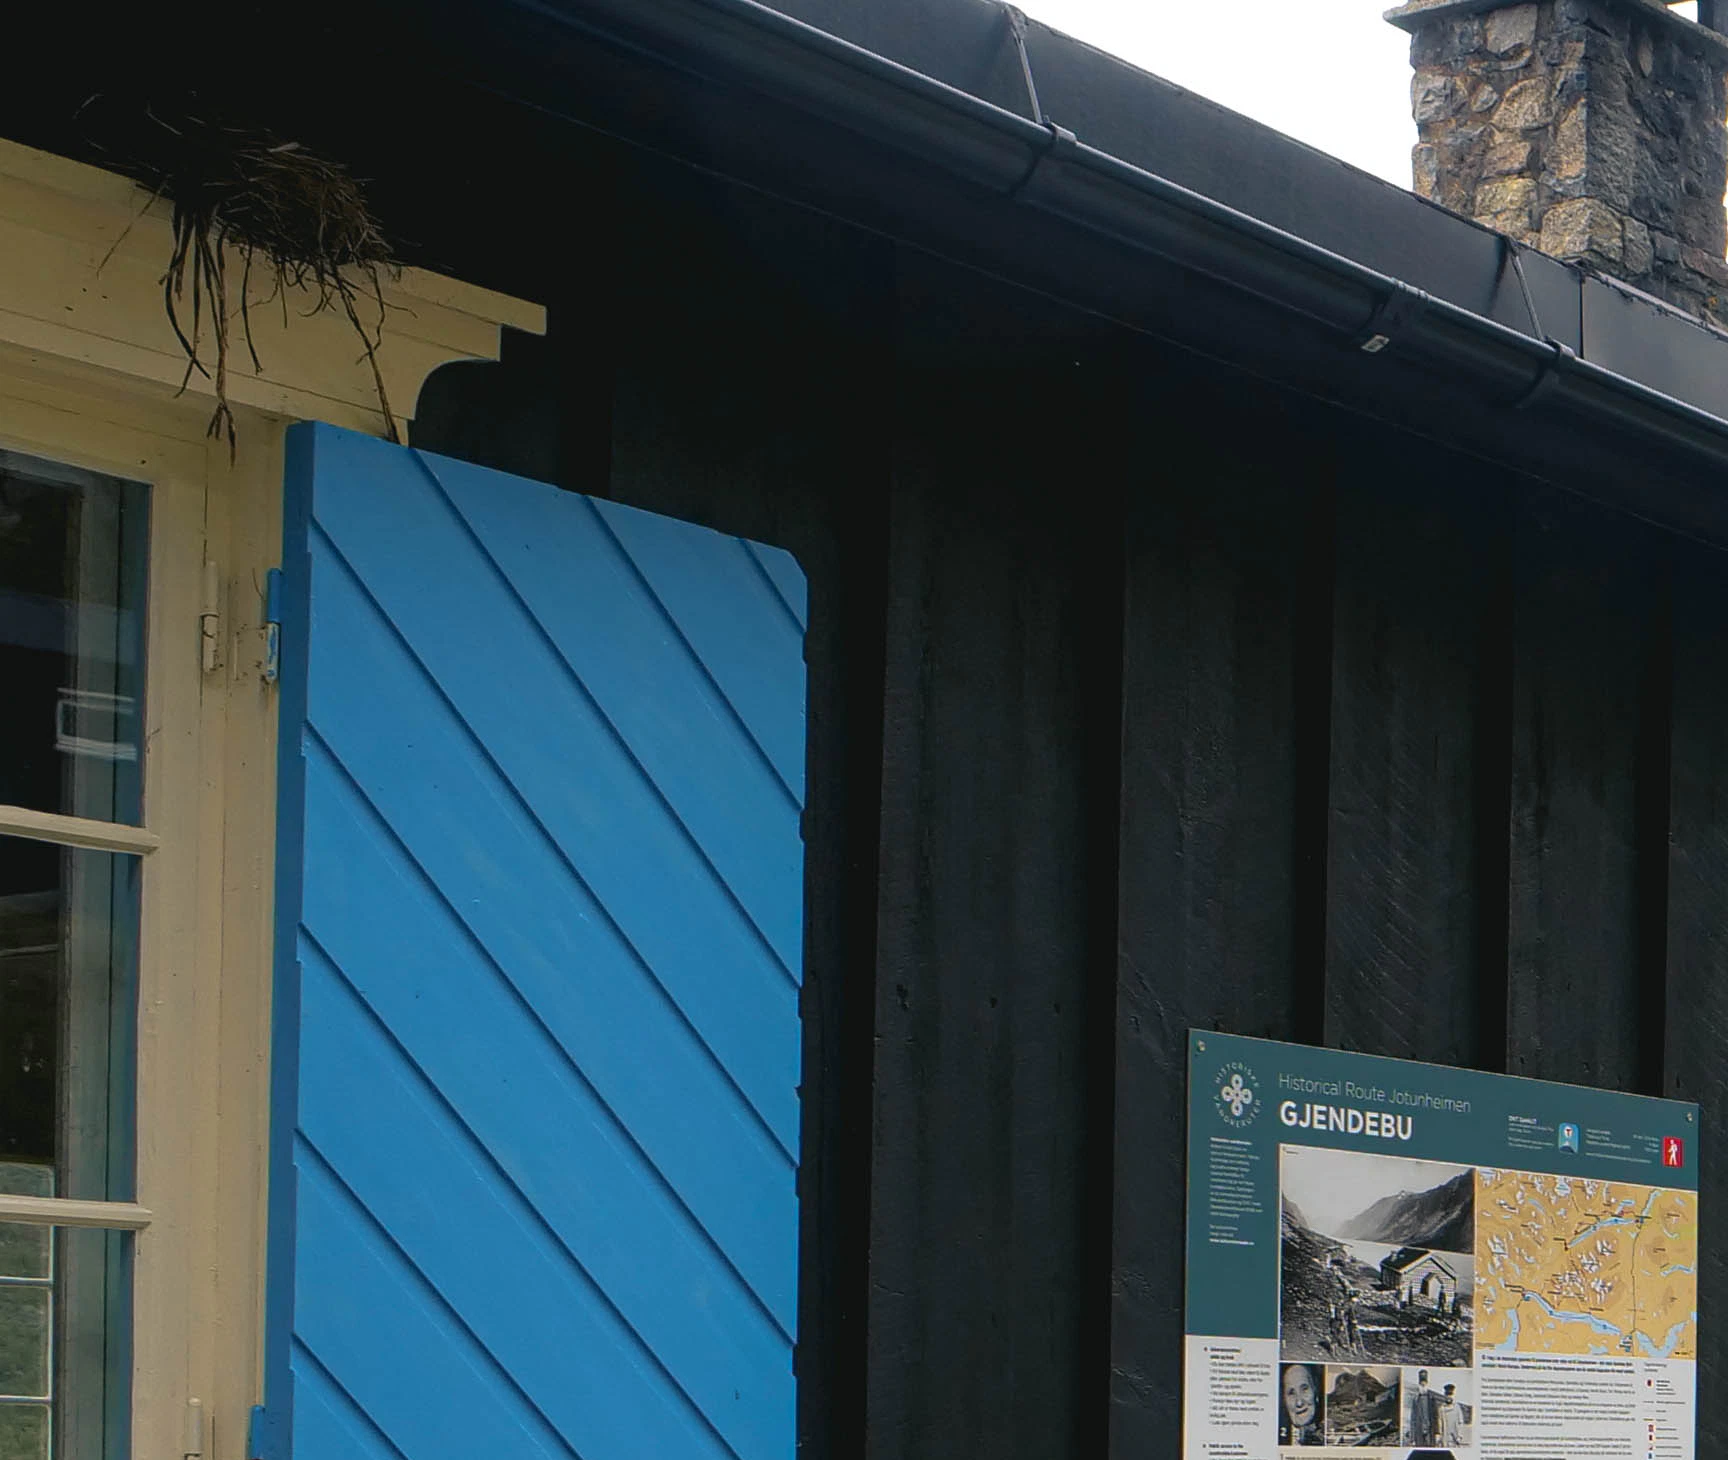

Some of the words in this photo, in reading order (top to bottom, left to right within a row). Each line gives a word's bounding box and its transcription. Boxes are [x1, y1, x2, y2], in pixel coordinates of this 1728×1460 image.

[1278, 1072, 1341, 1096] Historical
[1345, 1081, 1385, 1102] Route
[1389, 1089, 1471, 1113] Jotunheimen
[1280, 1100, 1413, 1141] GJENDEBU
